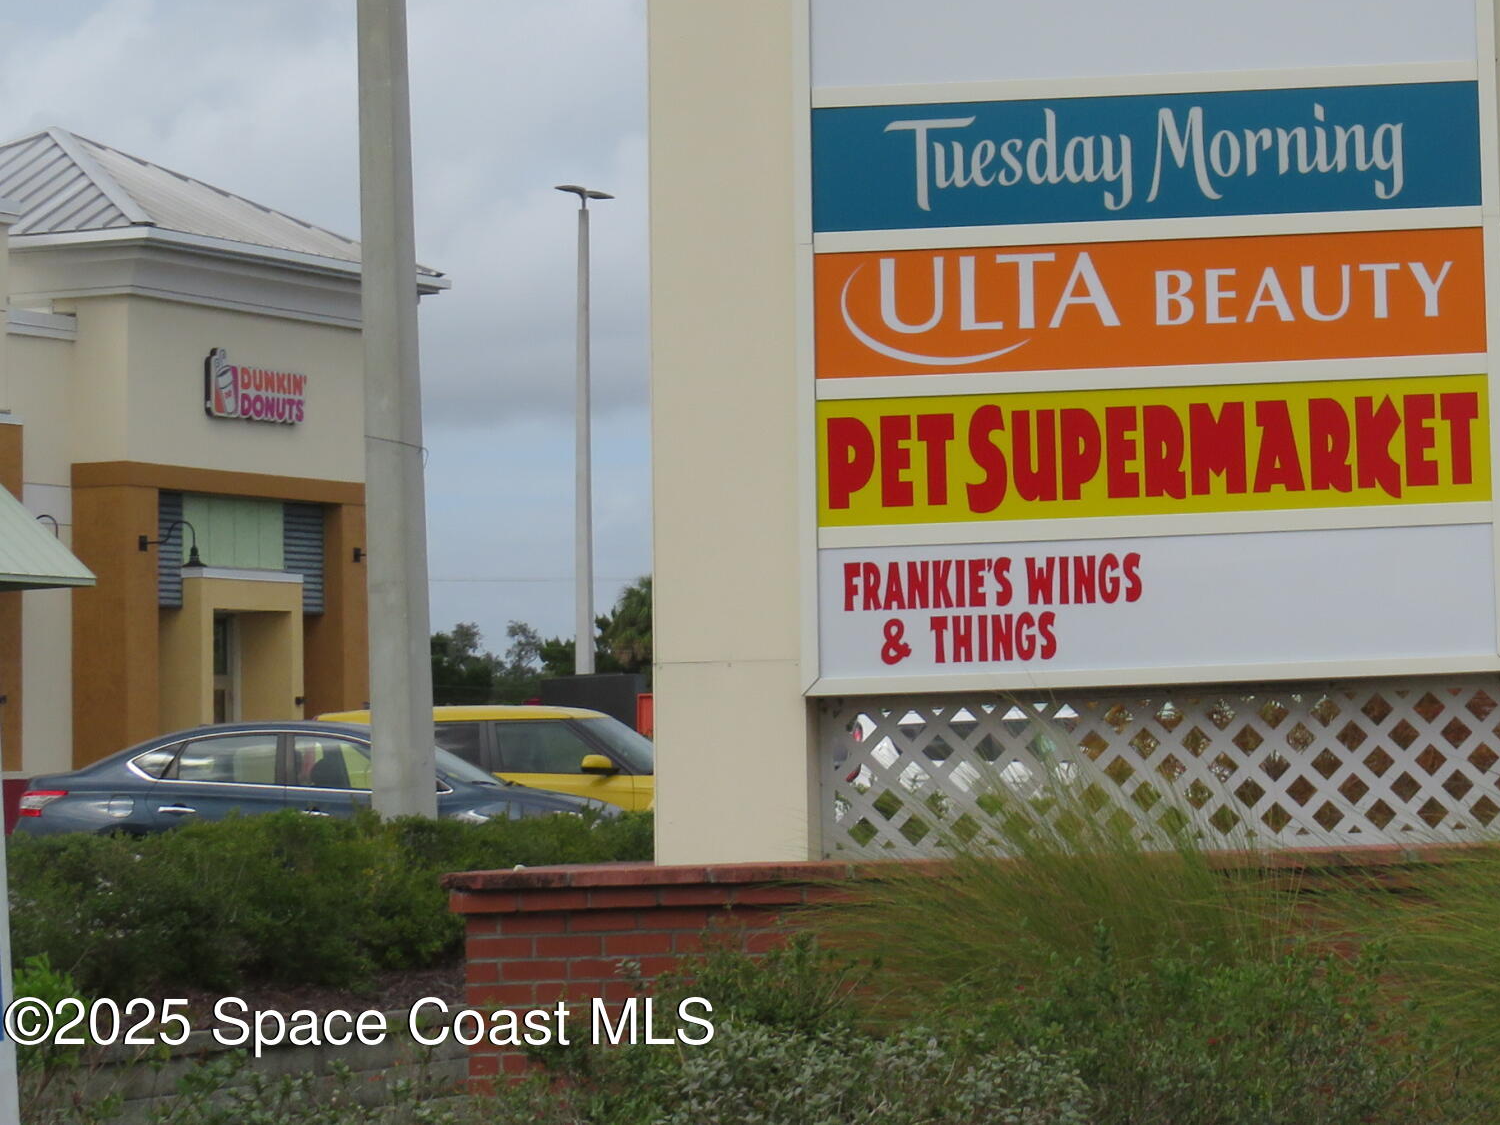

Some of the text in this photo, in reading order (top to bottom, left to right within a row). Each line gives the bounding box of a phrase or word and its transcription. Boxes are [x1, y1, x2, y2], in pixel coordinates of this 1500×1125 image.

[883, 101, 1404, 211] Tuesday Morning
[878, 252, 1454, 334] ULTA BEAUTY
[240, 366, 307, 397] DUNKIN'
[240, 392, 304, 422] DONUTS
[843, 552, 1143, 612] FRANKIE'S WINGS
[880, 611, 1057, 665] & THINGS
